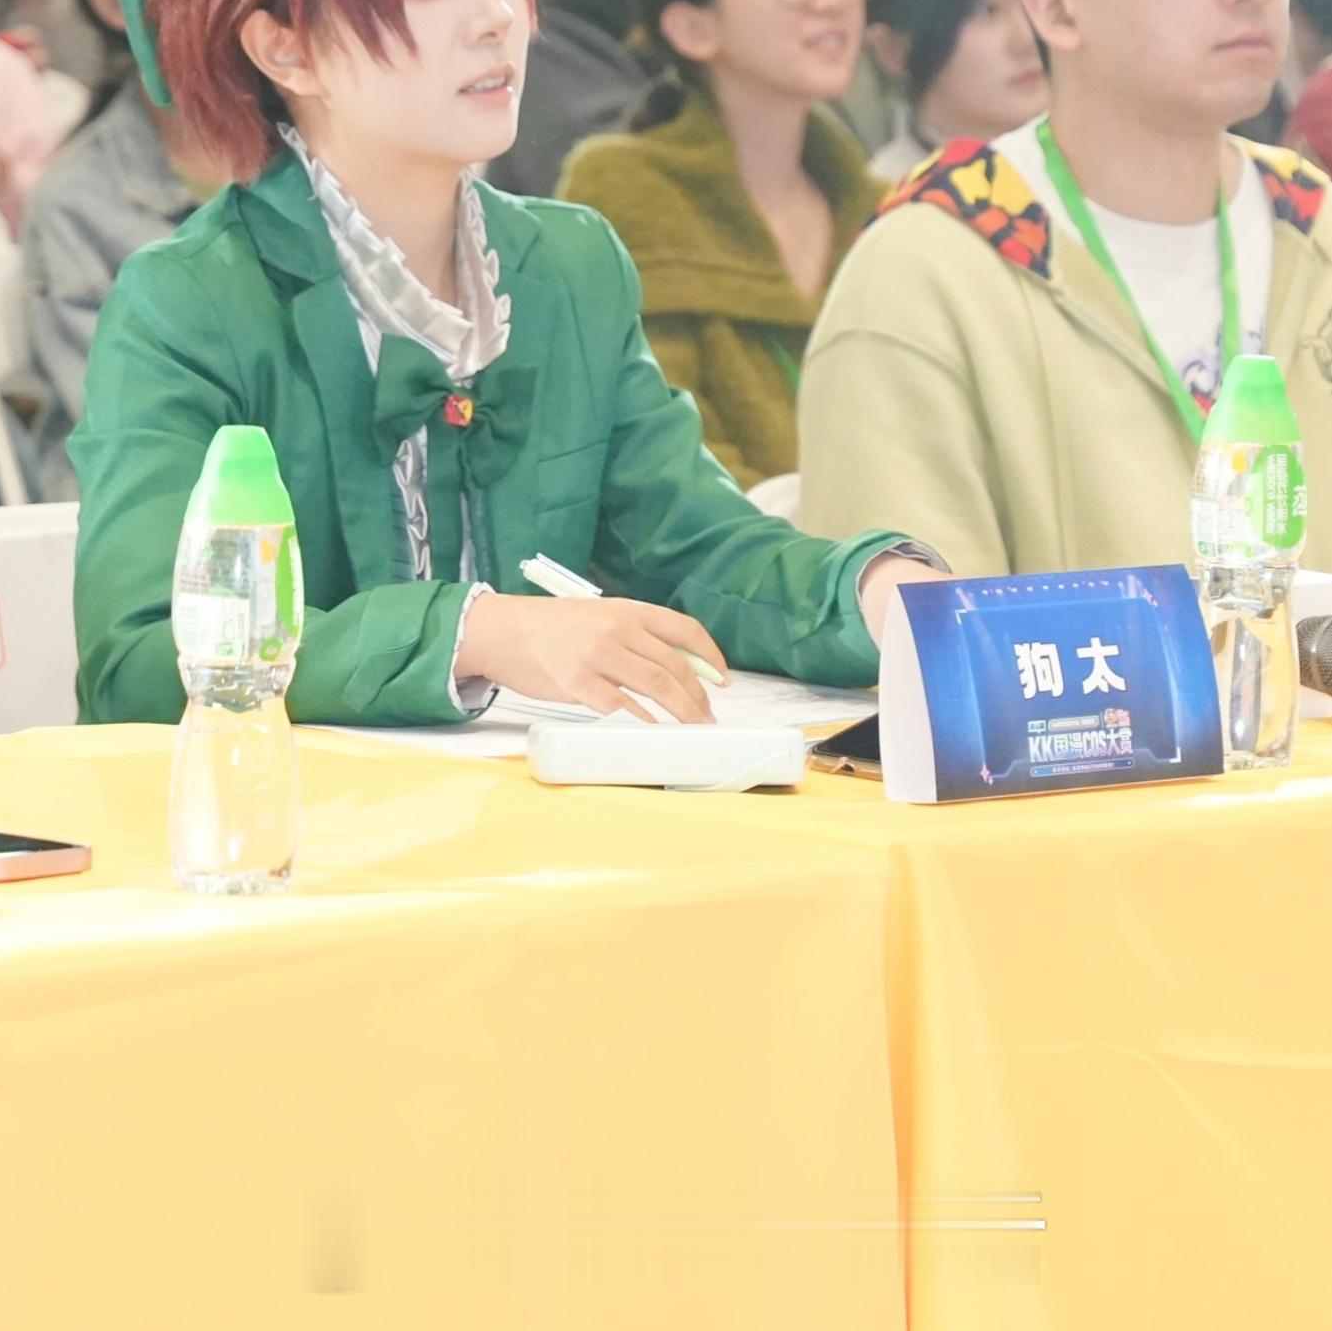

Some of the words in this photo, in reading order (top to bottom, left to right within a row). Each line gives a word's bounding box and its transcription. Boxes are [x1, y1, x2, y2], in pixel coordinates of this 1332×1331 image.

[1013, 636, 1127, 700] 狗太
[1027, 727, 1134, 763] KK国漫COS大赏
